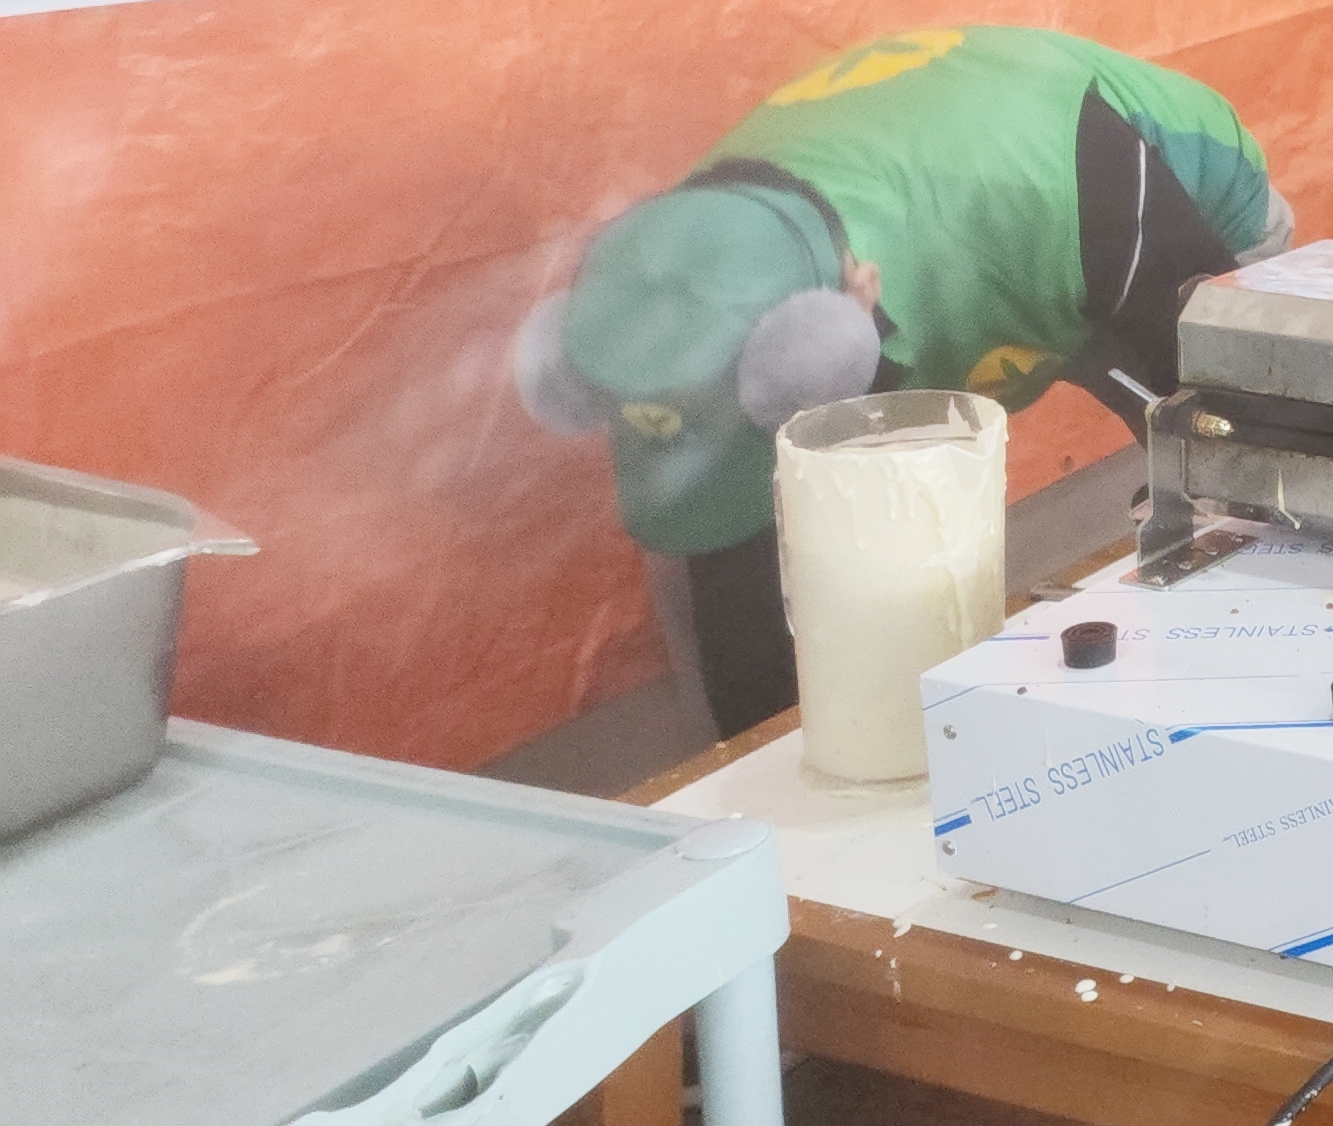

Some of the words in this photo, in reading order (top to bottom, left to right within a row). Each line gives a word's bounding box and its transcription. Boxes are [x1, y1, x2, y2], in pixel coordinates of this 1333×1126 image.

[1166, 624, 1318, 641] STAINLESS
[1047, 728, 1166, 796] STAINLESS
[972, 777, 1042, 822] STEEL
[1226, 820, 1275, 848] STEEL
